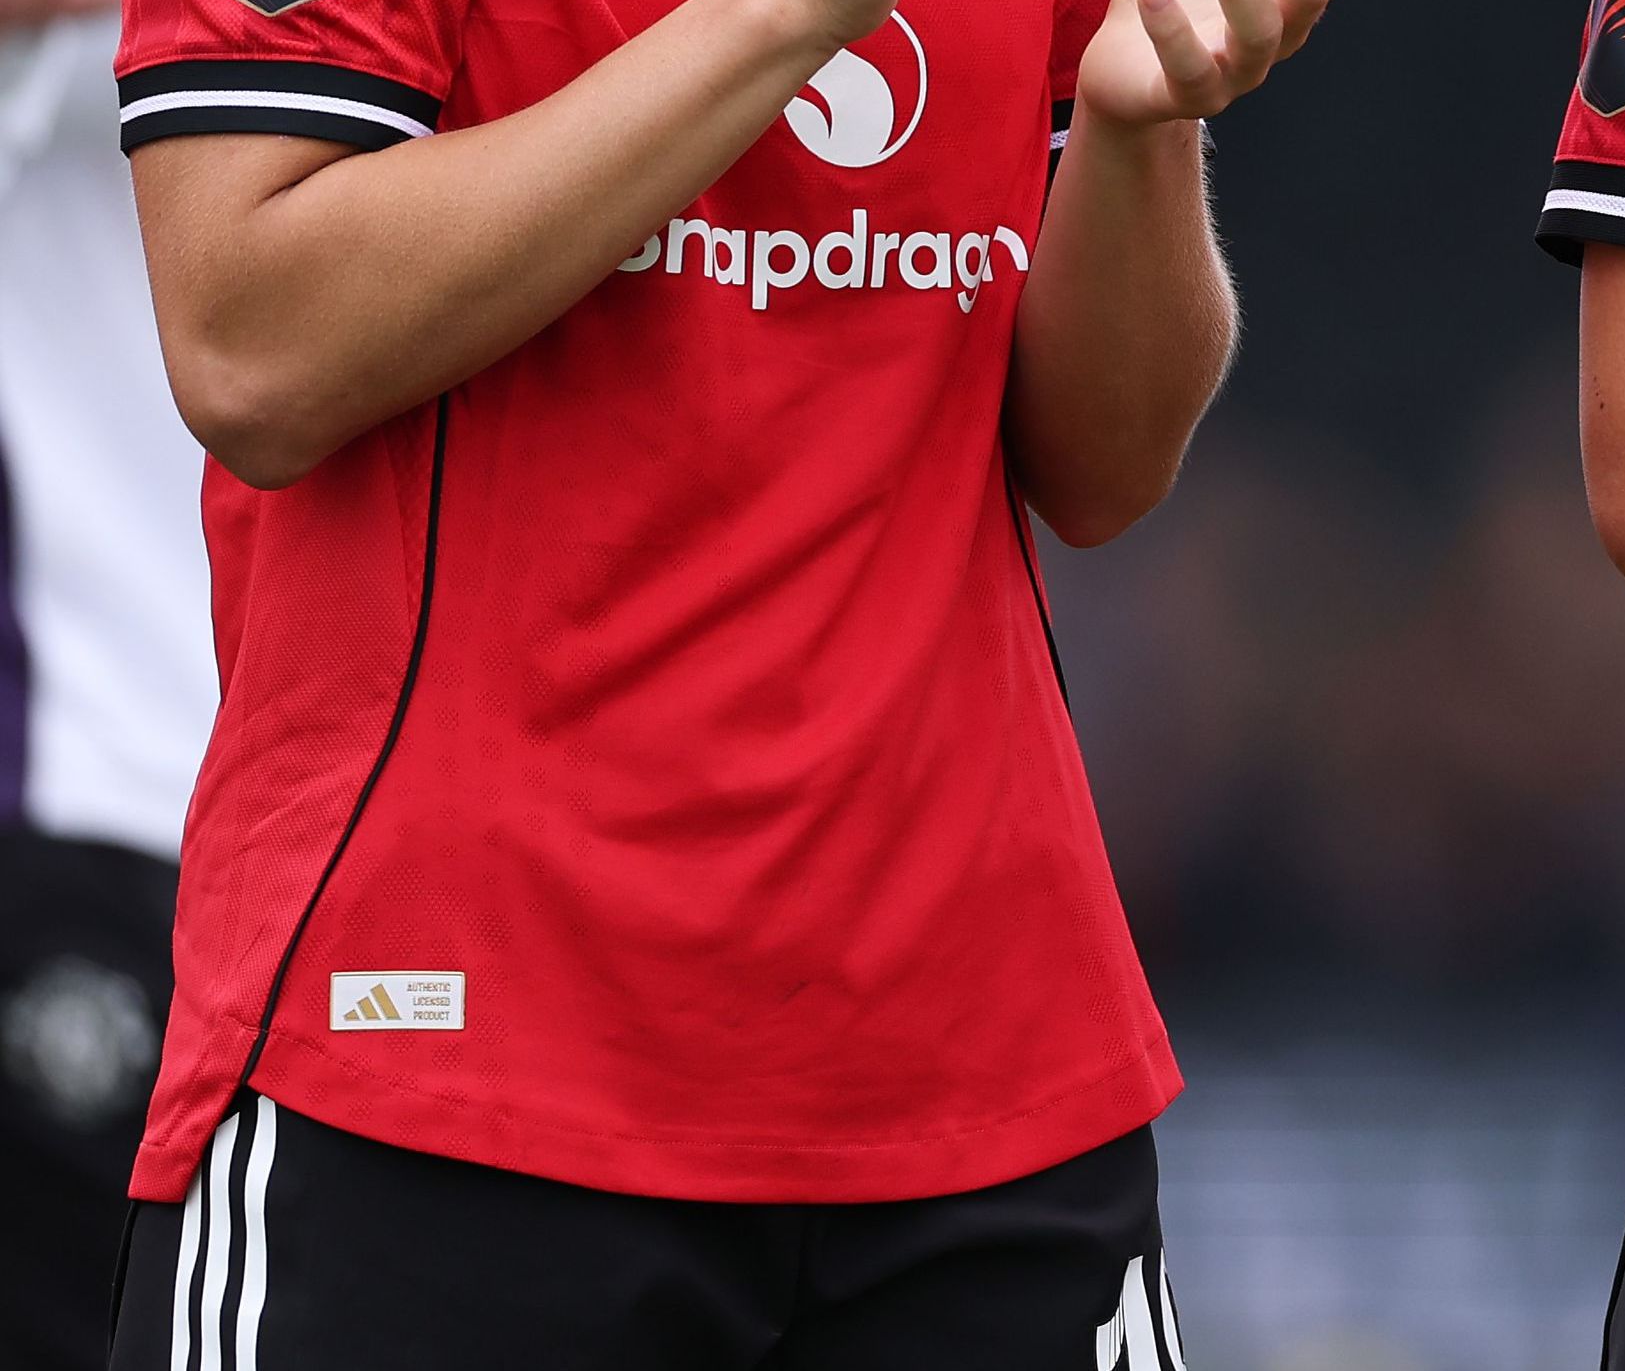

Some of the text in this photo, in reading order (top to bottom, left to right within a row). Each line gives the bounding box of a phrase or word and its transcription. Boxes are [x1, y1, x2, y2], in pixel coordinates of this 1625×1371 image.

[616, 209, 1028, 313] napdragn
[407, 981, 451, 992] AUTHENTIC
[413, 996, 451, 1007] LICENSED
[413, 1010, 450, 1021] PRODUCT
